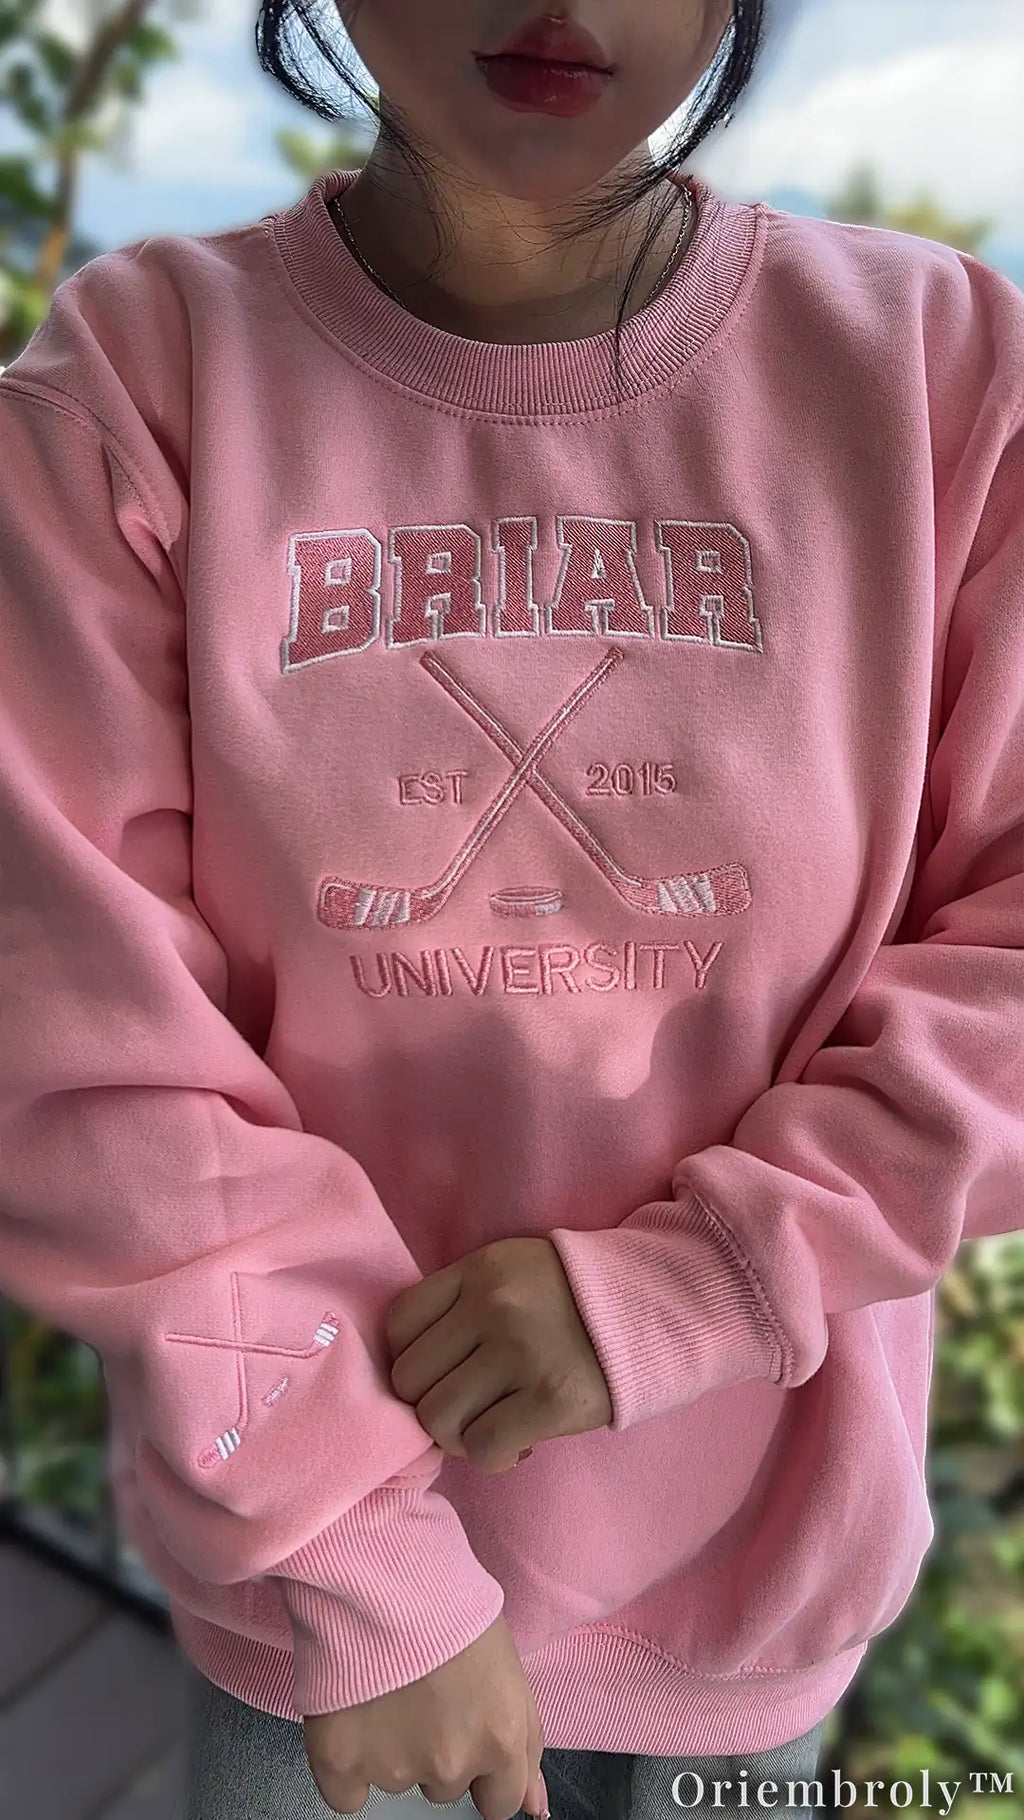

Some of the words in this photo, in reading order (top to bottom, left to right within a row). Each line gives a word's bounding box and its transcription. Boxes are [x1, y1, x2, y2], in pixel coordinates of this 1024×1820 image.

[281, 515, 764, 675] BRIAR
[398, 769, 469, 805] EST
[585, 762, 678, 798] 2015
[349, 941, 724, 998] UNIVERSITY
